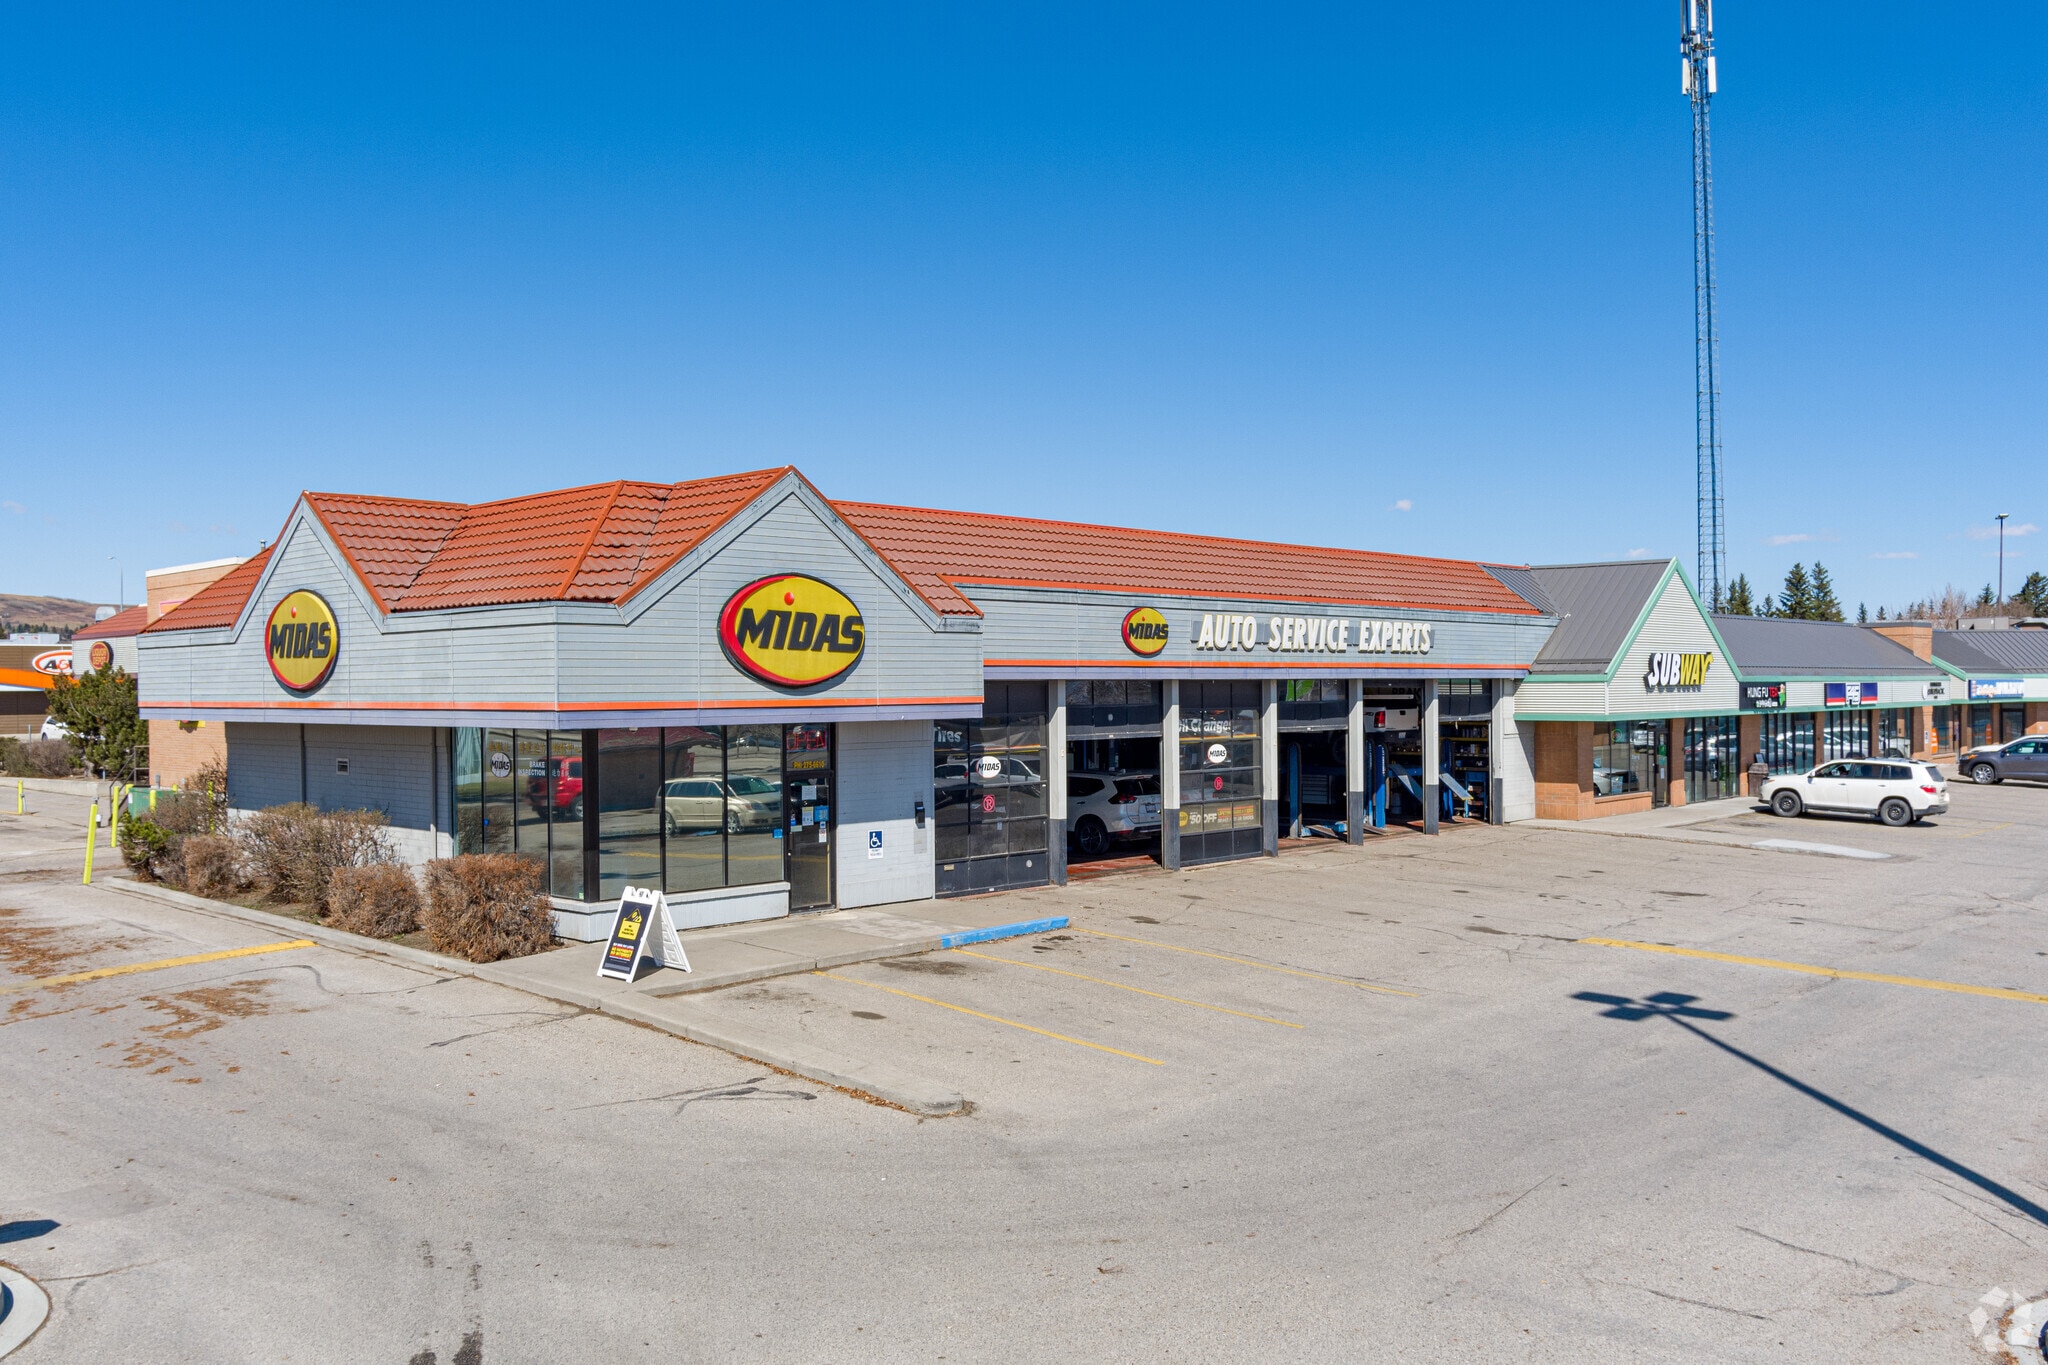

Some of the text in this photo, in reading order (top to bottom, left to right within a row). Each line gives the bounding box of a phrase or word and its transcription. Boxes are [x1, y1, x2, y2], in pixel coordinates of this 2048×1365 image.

[269, 621, 332, 659] MIDAS
[736, 608, 864, 654] MIDAS
[1128, 621, 1169, 641] MIDAS
[1197, 614, 1433, 654] AUTO SERVICE EXPERTS
[43, 659, 72, 670] A&
[1647, 652, 1714, 688] SUBWAY
[1762, 687, 1769, 698] FU
[786, 730, 827, 750] OPEN
[491, 760, 510, 770] MIDAS
[977, 762, 1001, 771] MIDAS
[1203, 813, 1217, 823] OFF
